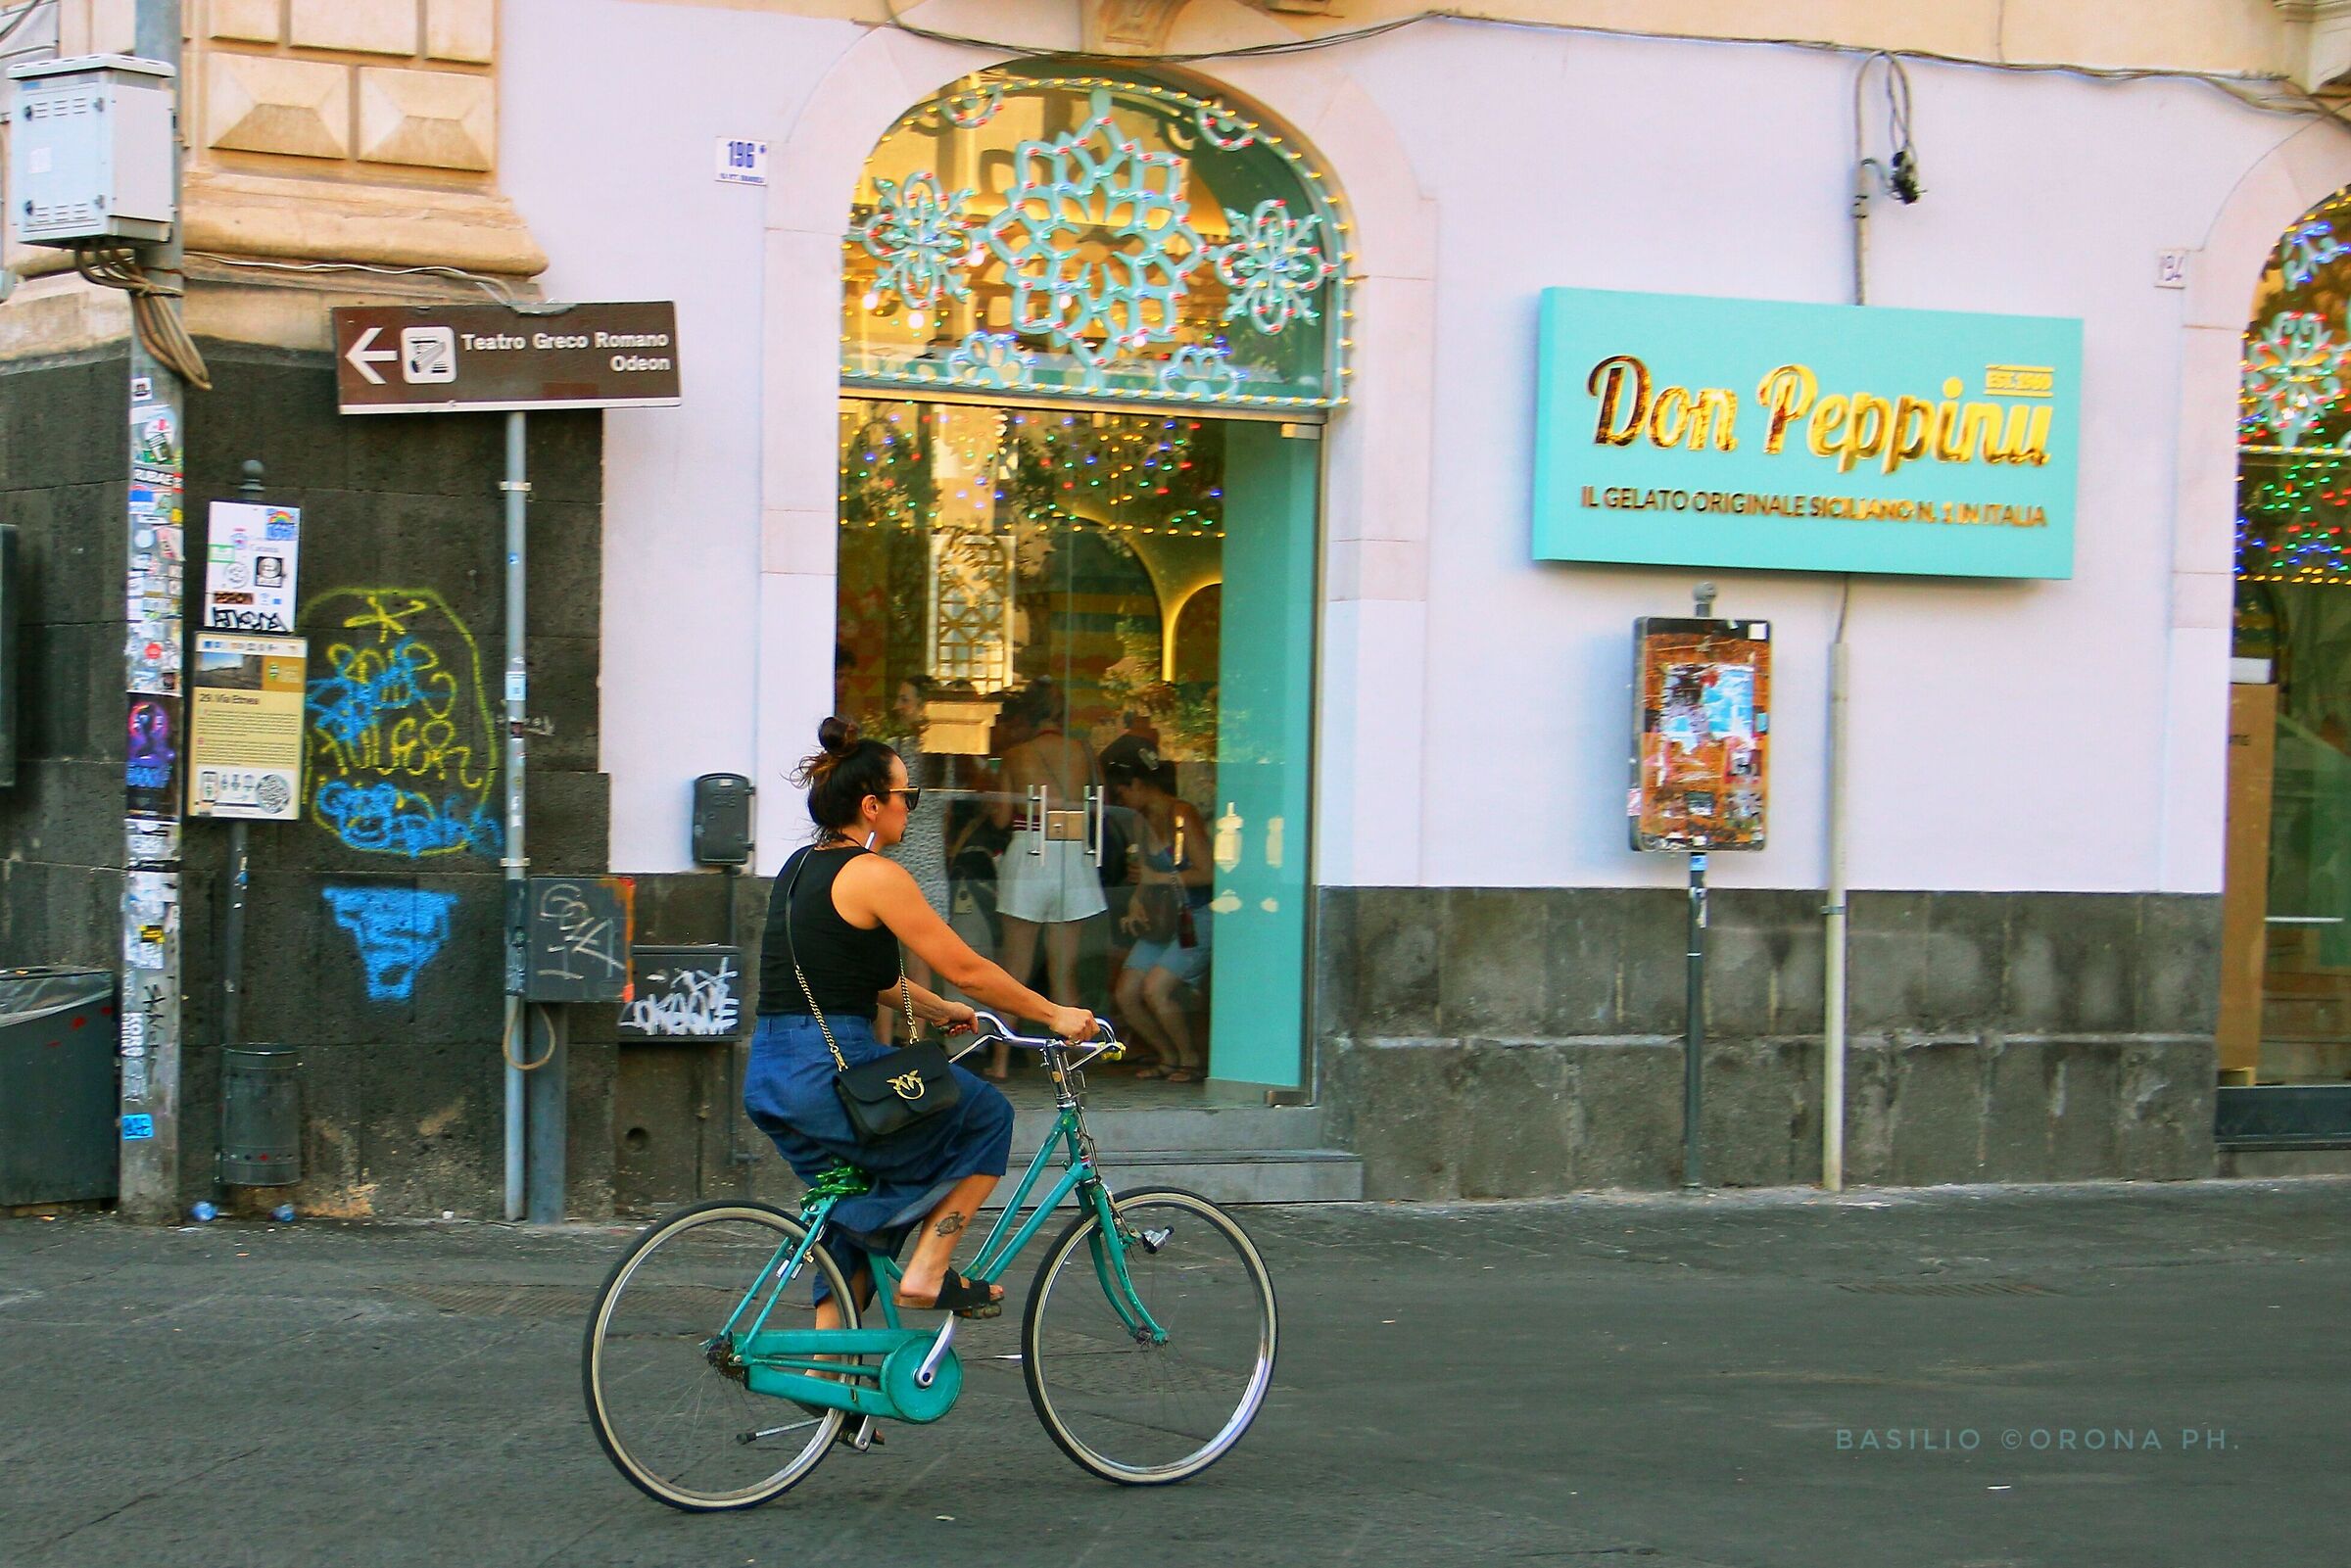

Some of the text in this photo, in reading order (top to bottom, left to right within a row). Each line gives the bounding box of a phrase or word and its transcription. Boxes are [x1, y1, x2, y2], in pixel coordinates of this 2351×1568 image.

[460, 331, 669, 351] Teatro Greco Romano
[609, 355, 671, 371] Odeon
[1586, 355, 2054, 474] Don Peppinu
[1581, 486, 1599, 507] IL
[1604, 487, 1689, 511] GELATO
[1692, 491, 1807, 517] ORIGINALE
[1810, 496, 1915, 521] SICILIANO
[1941, 501, 1954, 524] 1
[1957, 502, 1980, 525] IN
[1982, 503, 2048, 528] ITALIA
